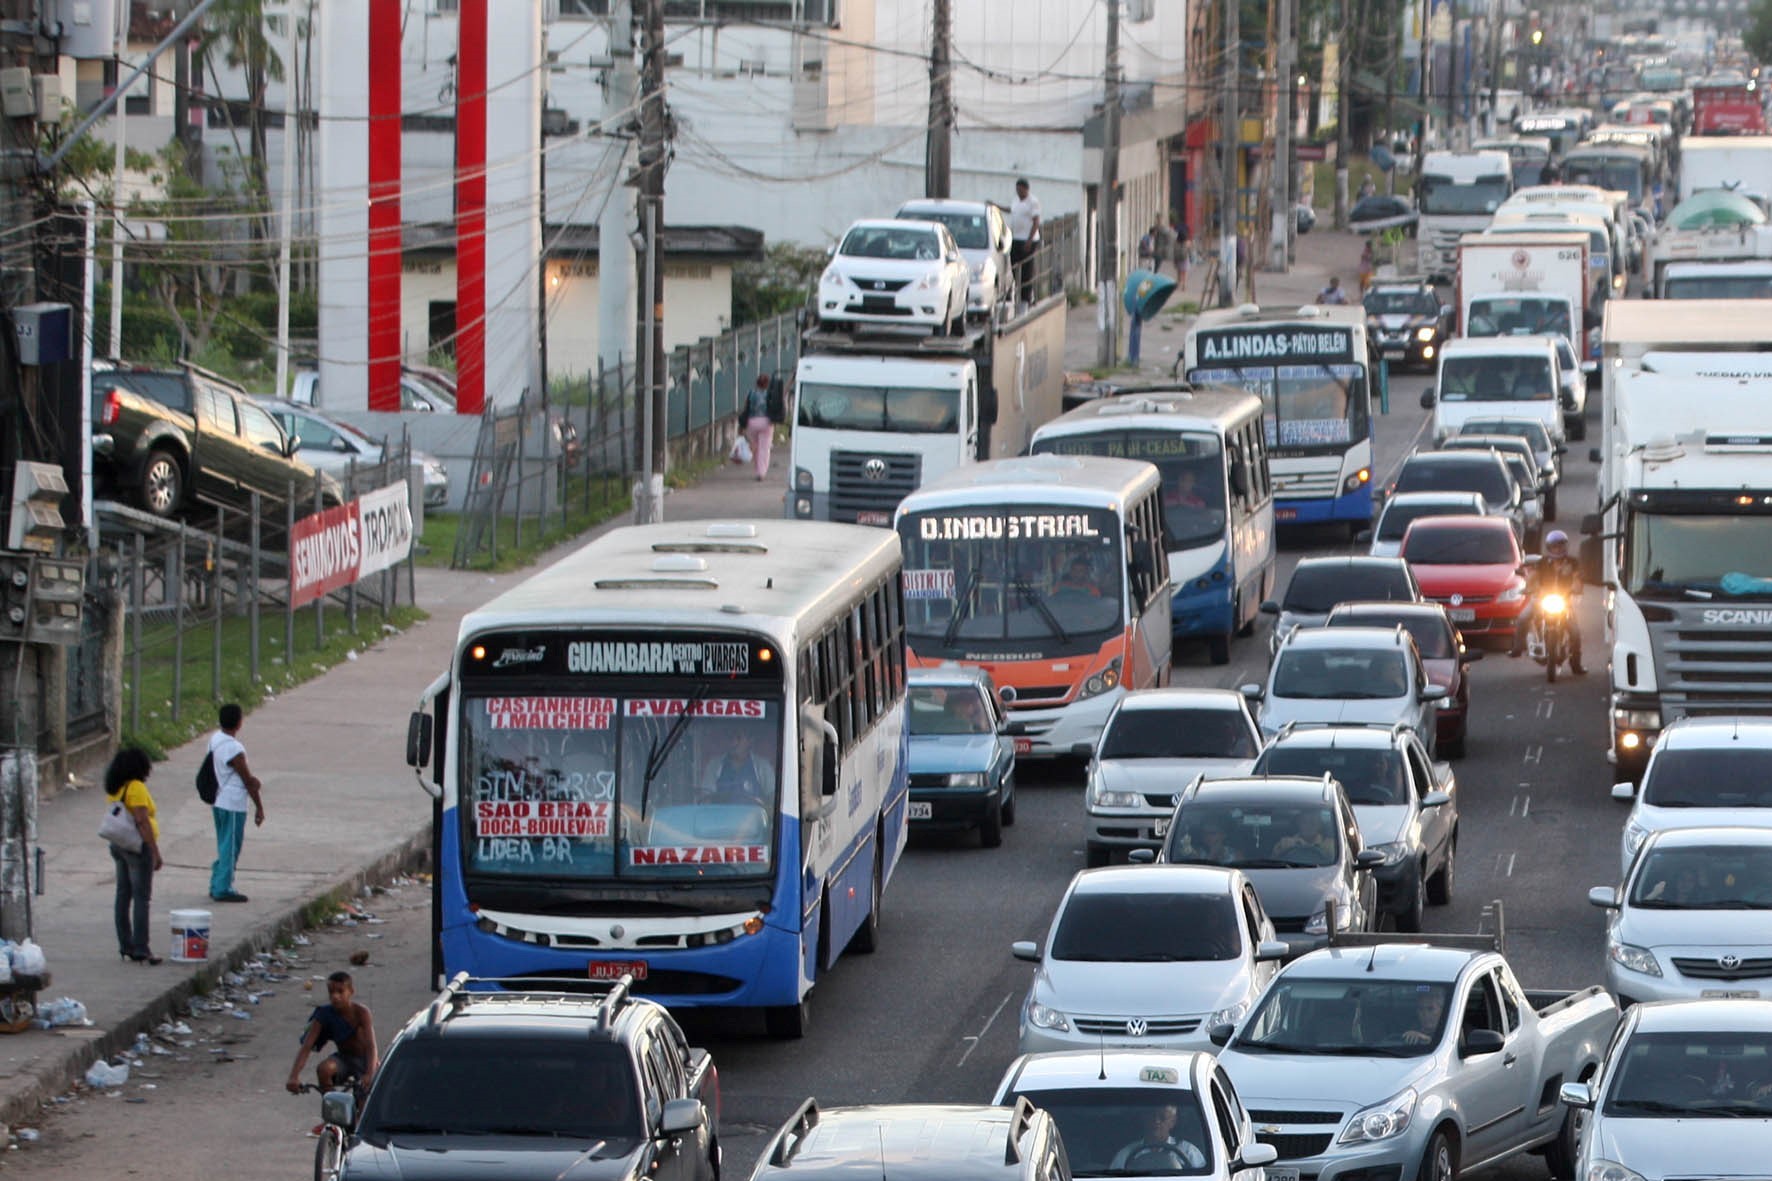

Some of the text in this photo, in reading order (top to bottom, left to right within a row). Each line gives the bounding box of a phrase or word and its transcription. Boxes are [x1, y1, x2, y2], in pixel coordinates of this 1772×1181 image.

[921, 514, 1099, 540] D.INDUSTRIAL
[567, 641, 674, 674] GUANABARA
[488, 698, 615, 714] CASTANHEIRA
[629, 700, 763, 716] P.VARGAS
[479, 802, 607, 817] SAO BRAZ
[480, 819, 606, 835] DOCA-BOULEVAR
[633, 847, 765, 865] NAZARE
